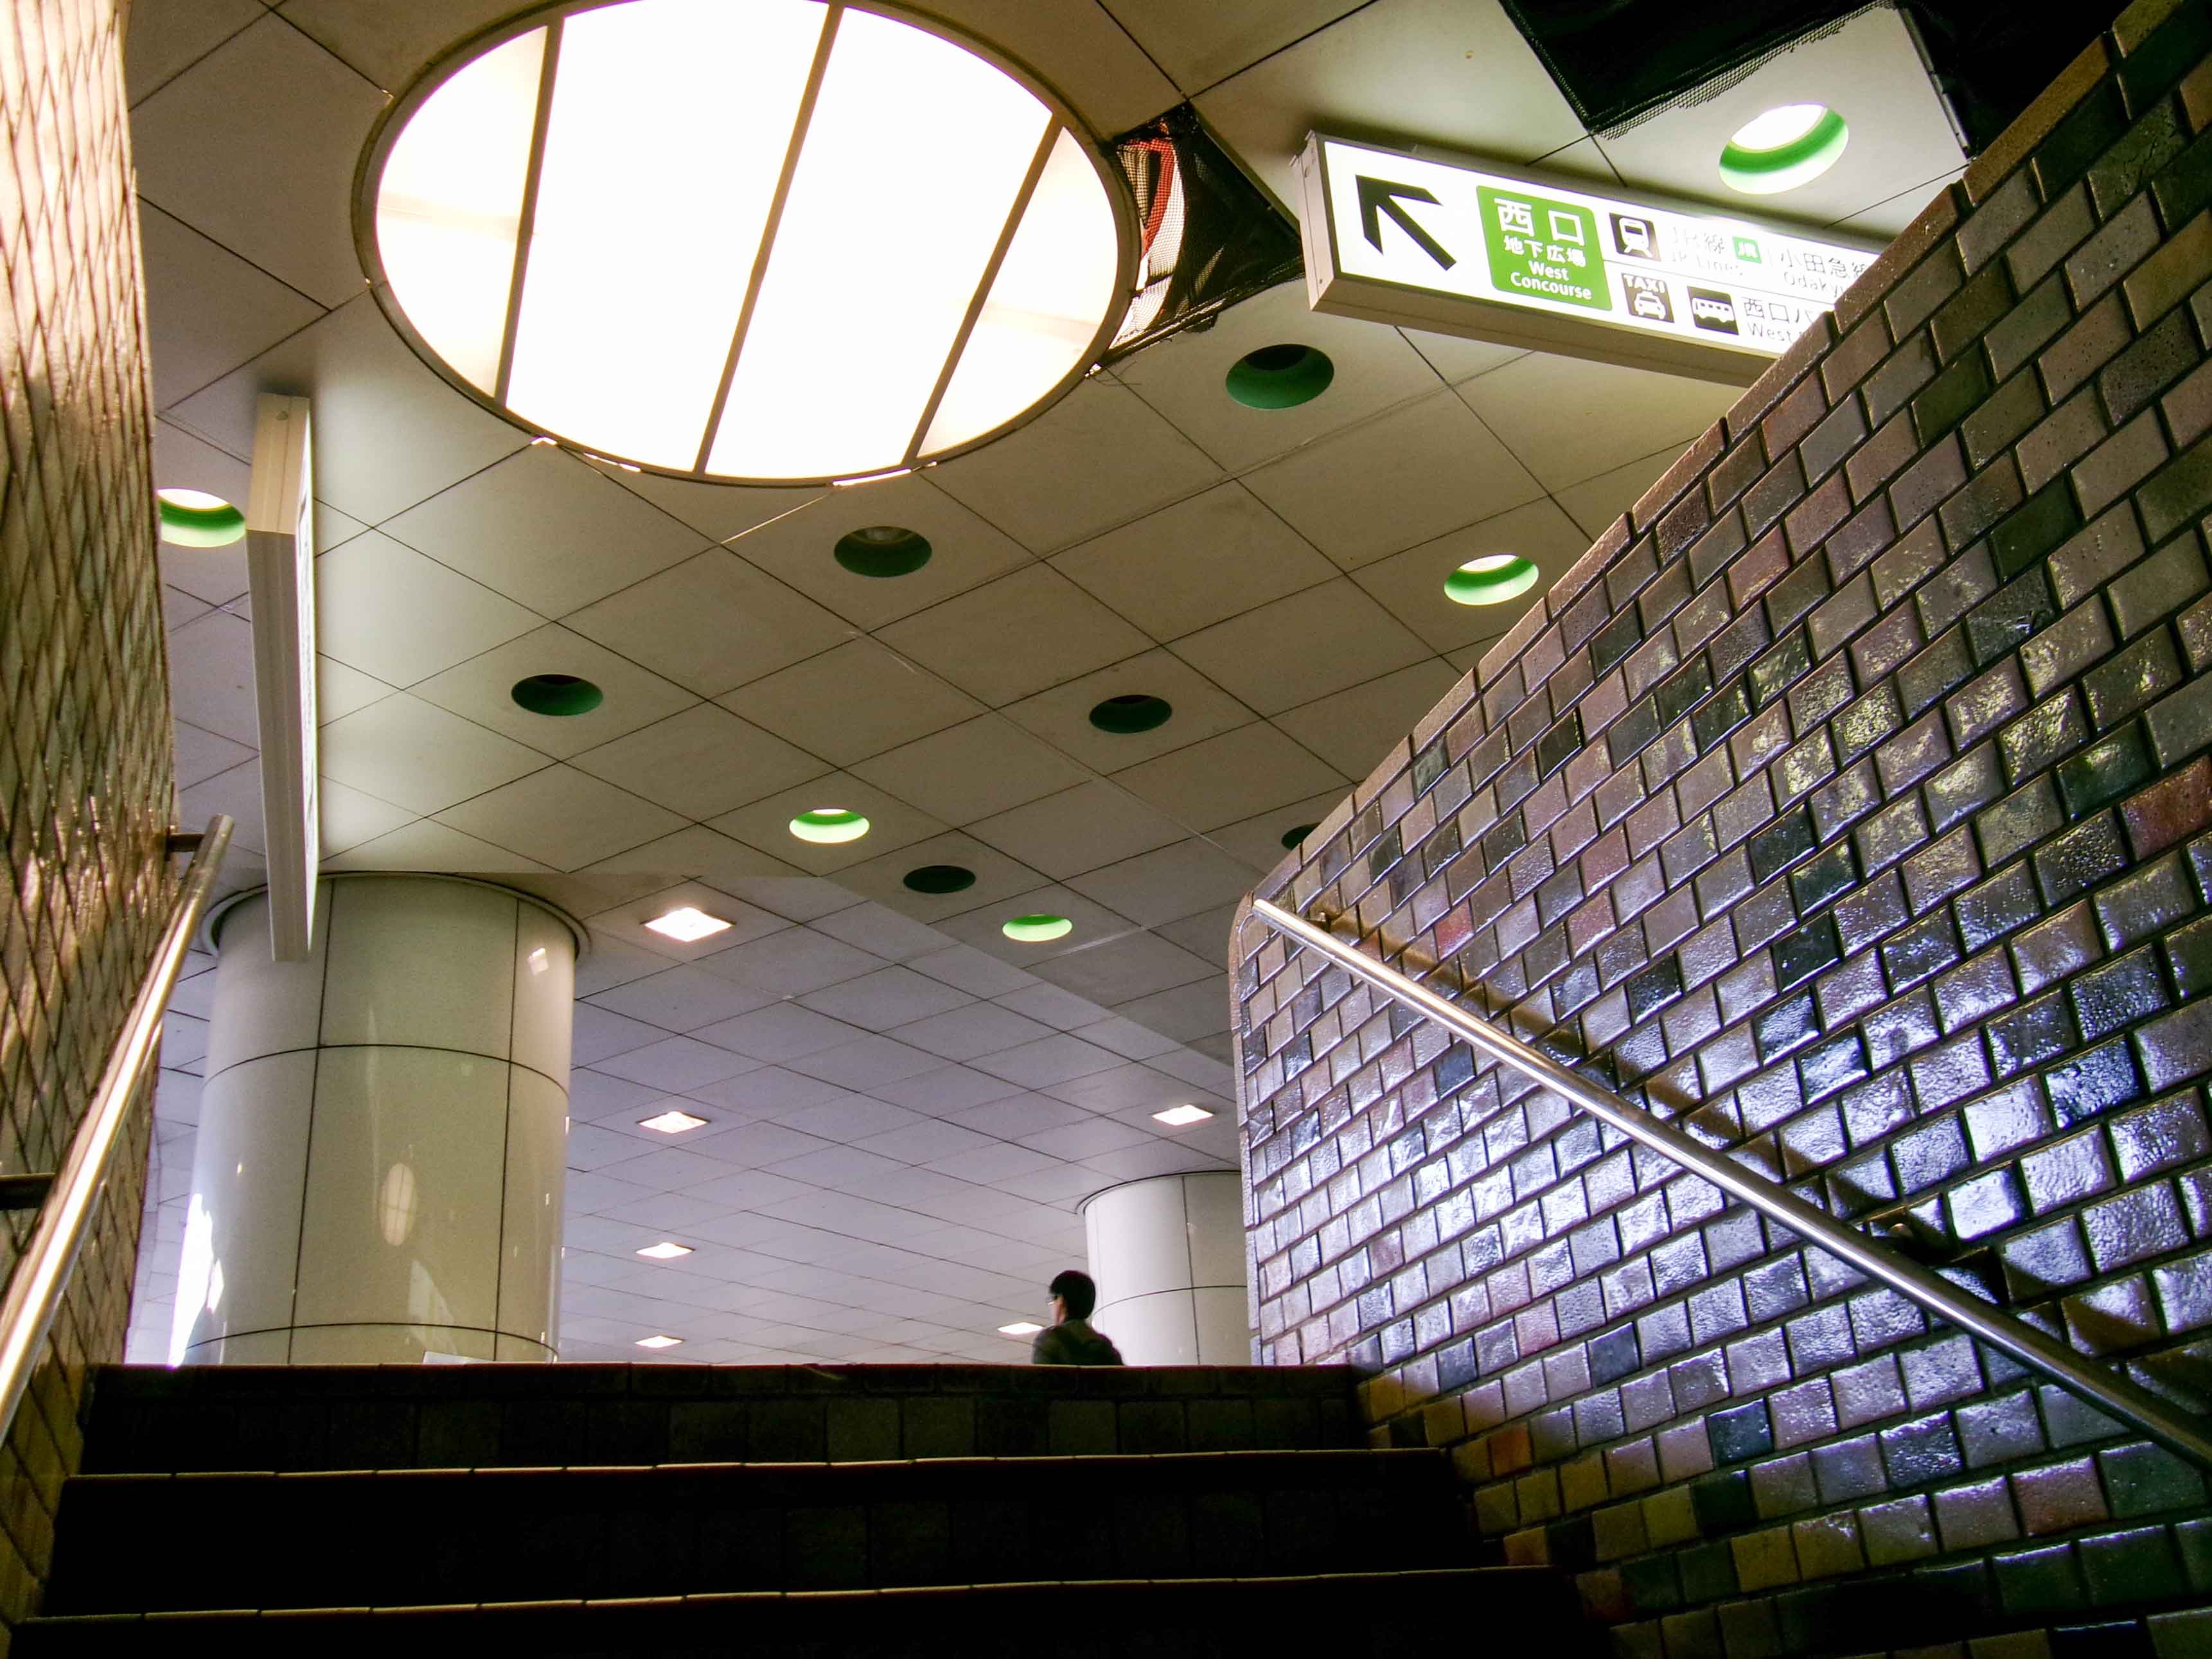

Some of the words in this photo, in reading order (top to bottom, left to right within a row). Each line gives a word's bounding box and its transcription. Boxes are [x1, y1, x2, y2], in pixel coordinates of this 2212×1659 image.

[1494, 197, 1585, 246] 西口
[1503, 235, 1586, 267] 地下広場
[1528, 260, 1570, 281] West
[1624, 274, 1666, 293] TAXI
[1510, 272, 1592, 300] Concourse
